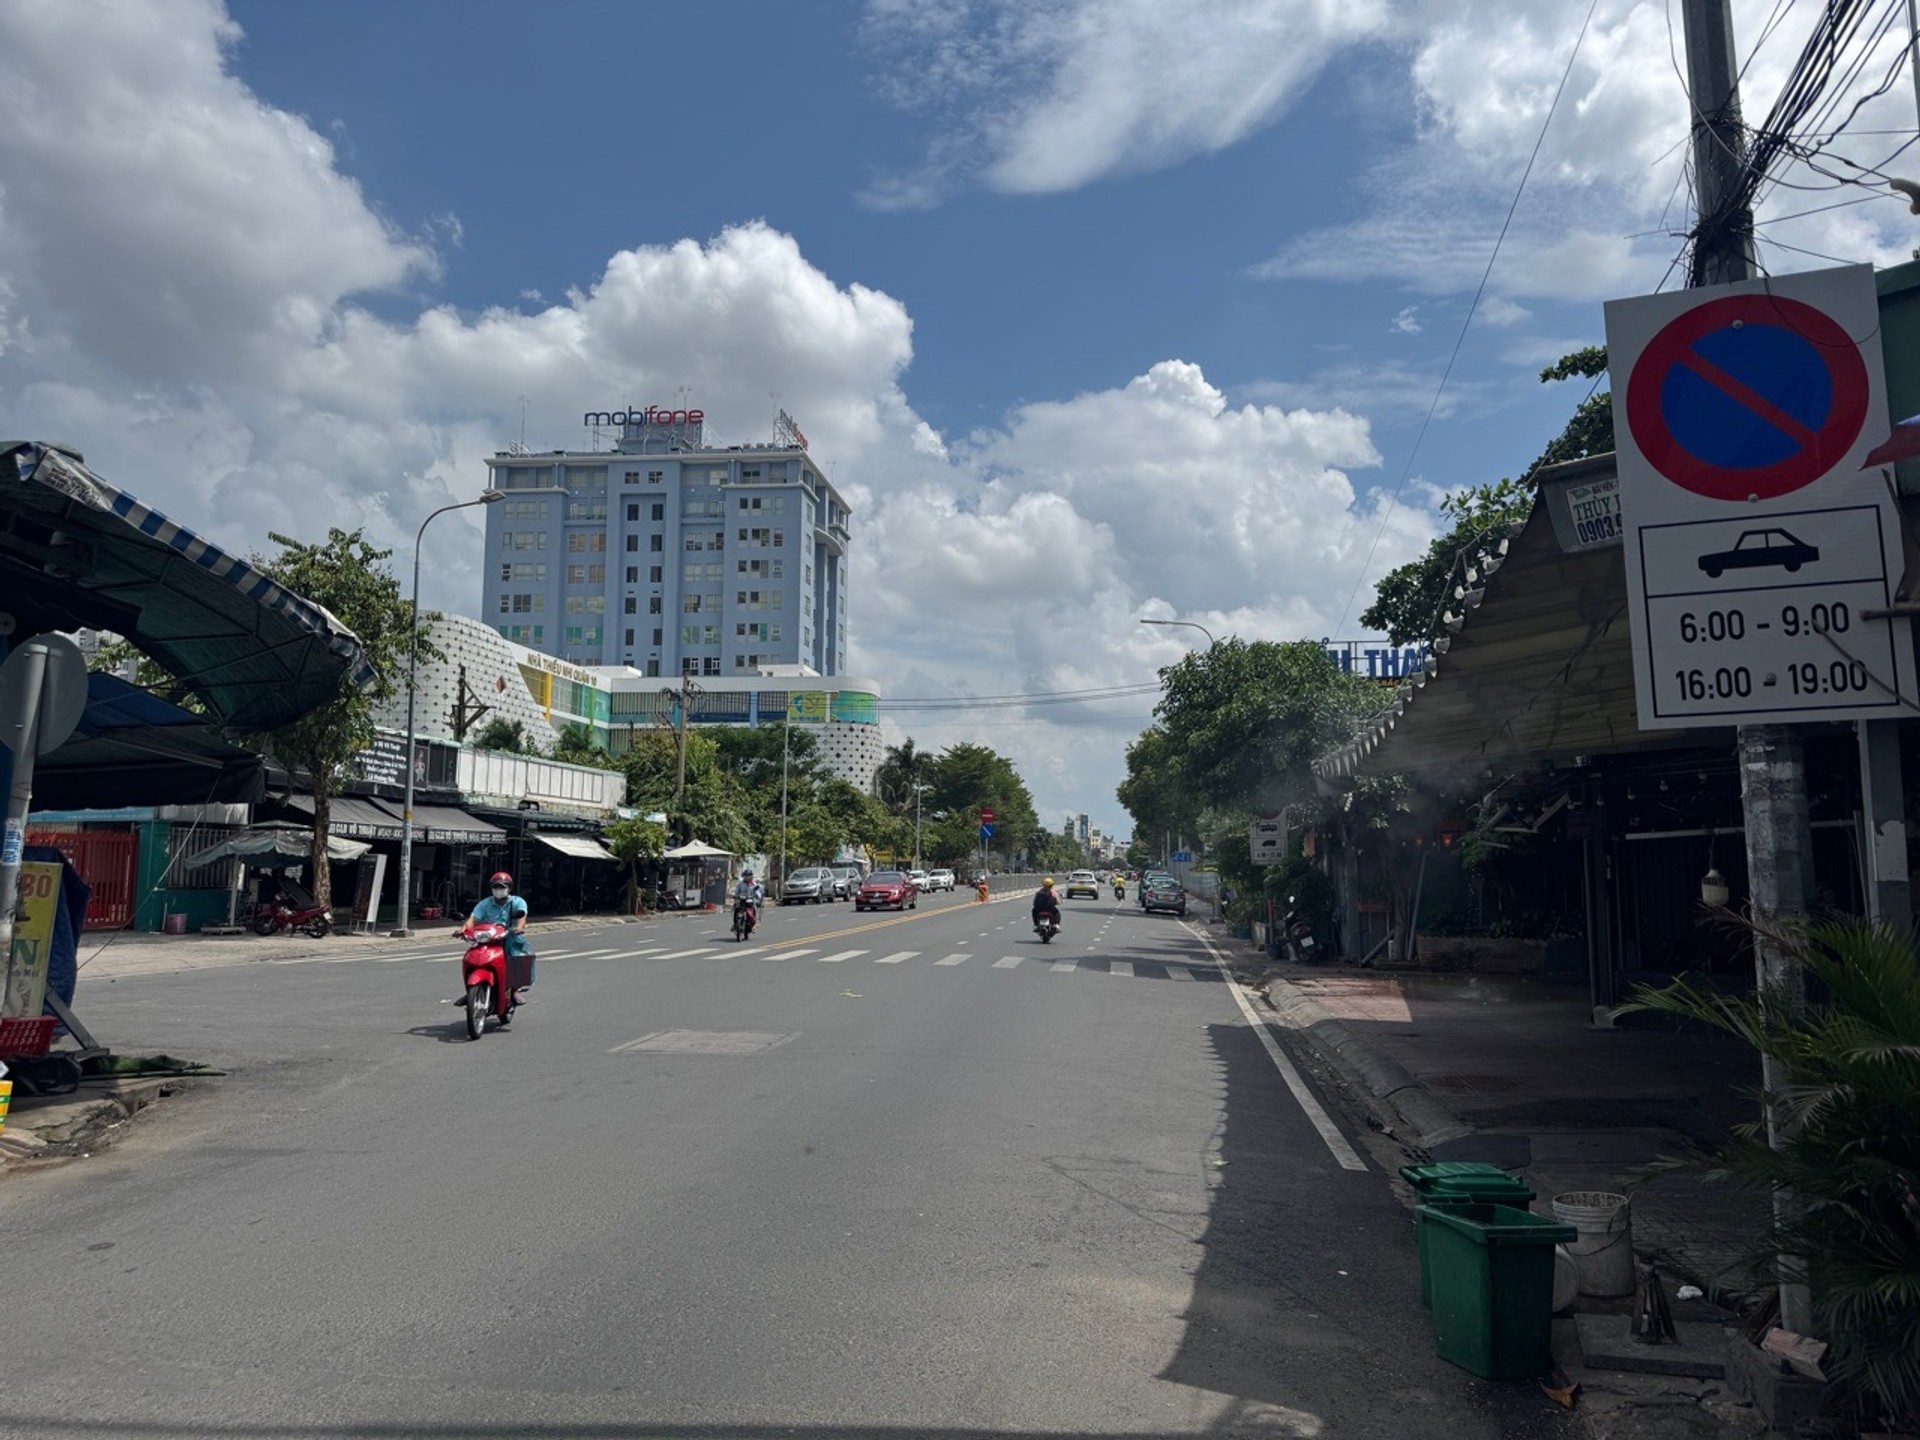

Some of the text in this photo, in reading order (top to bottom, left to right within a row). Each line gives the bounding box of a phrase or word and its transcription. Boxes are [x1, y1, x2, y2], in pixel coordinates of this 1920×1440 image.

[584, 405, 704, 427] mobifone
[1680, 609, 1745, 643] 6:00
[1781, 602, 1850, 637] 9:00
[1675, 666, 1752, 701] 16:00
[1787, 660, 1868, 695] 19:00
